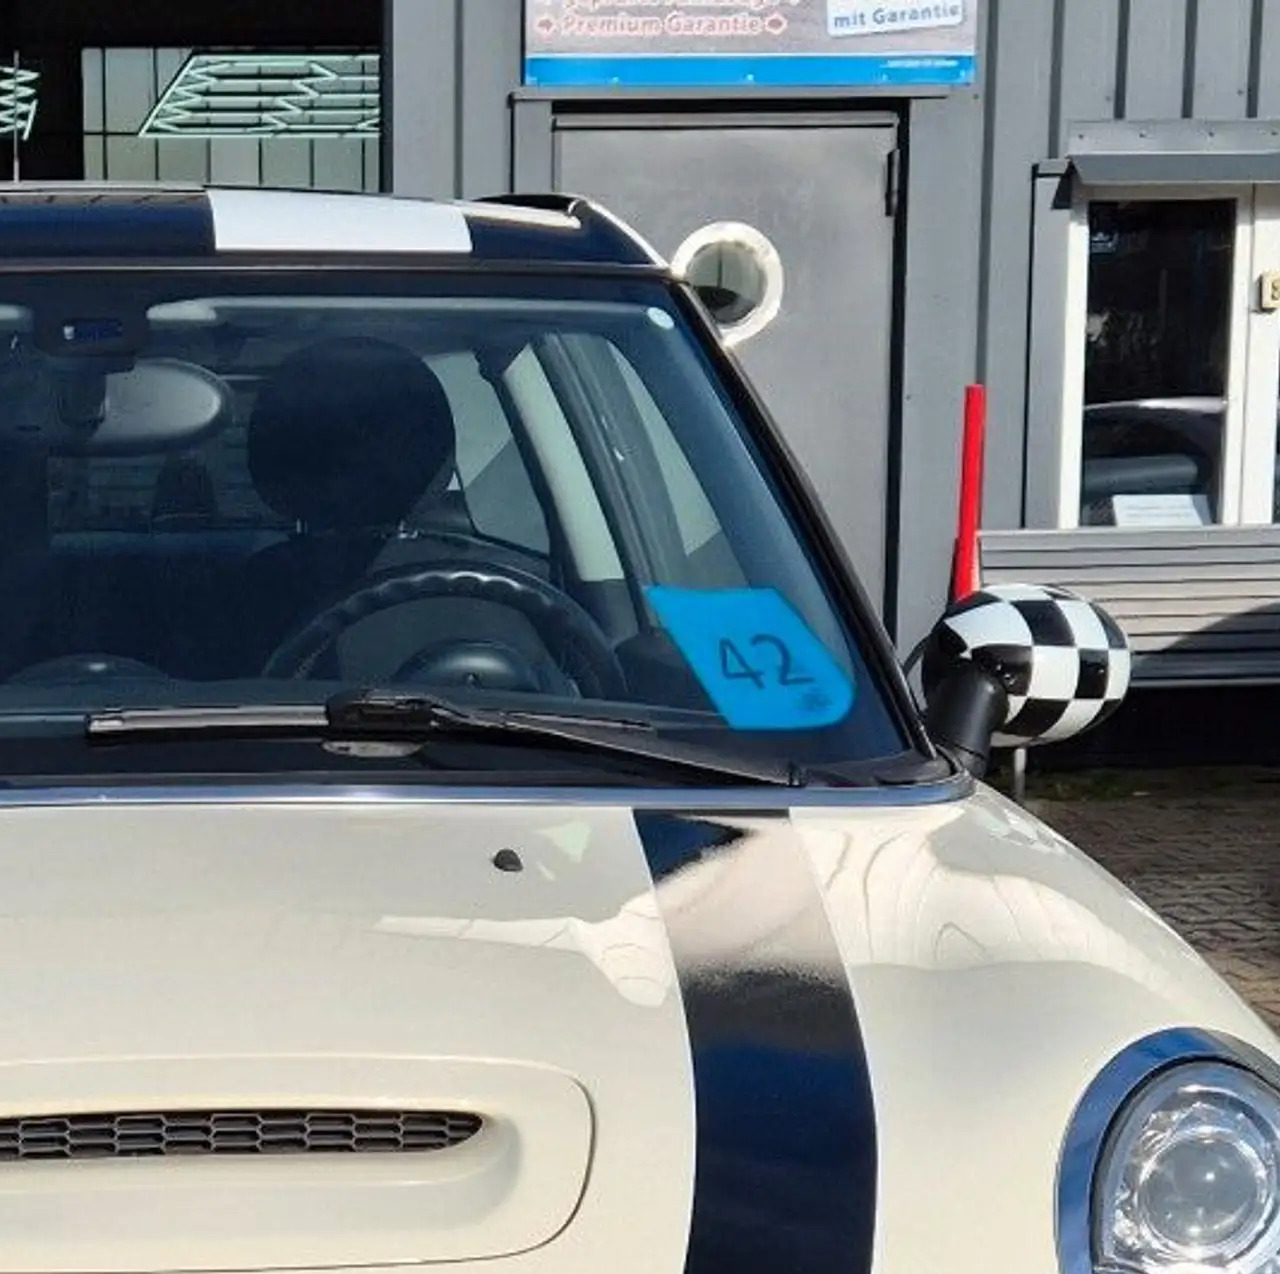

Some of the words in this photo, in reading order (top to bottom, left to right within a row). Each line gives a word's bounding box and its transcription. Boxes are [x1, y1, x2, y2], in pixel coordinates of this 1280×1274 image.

[564, 15, 659, 34] Premium
[668, 14, 761, 34] Garantie
[833, 13, 866, 28] mit
[872, 4, 961, 25] Garantie
[718, 633, 815, 689] 42
